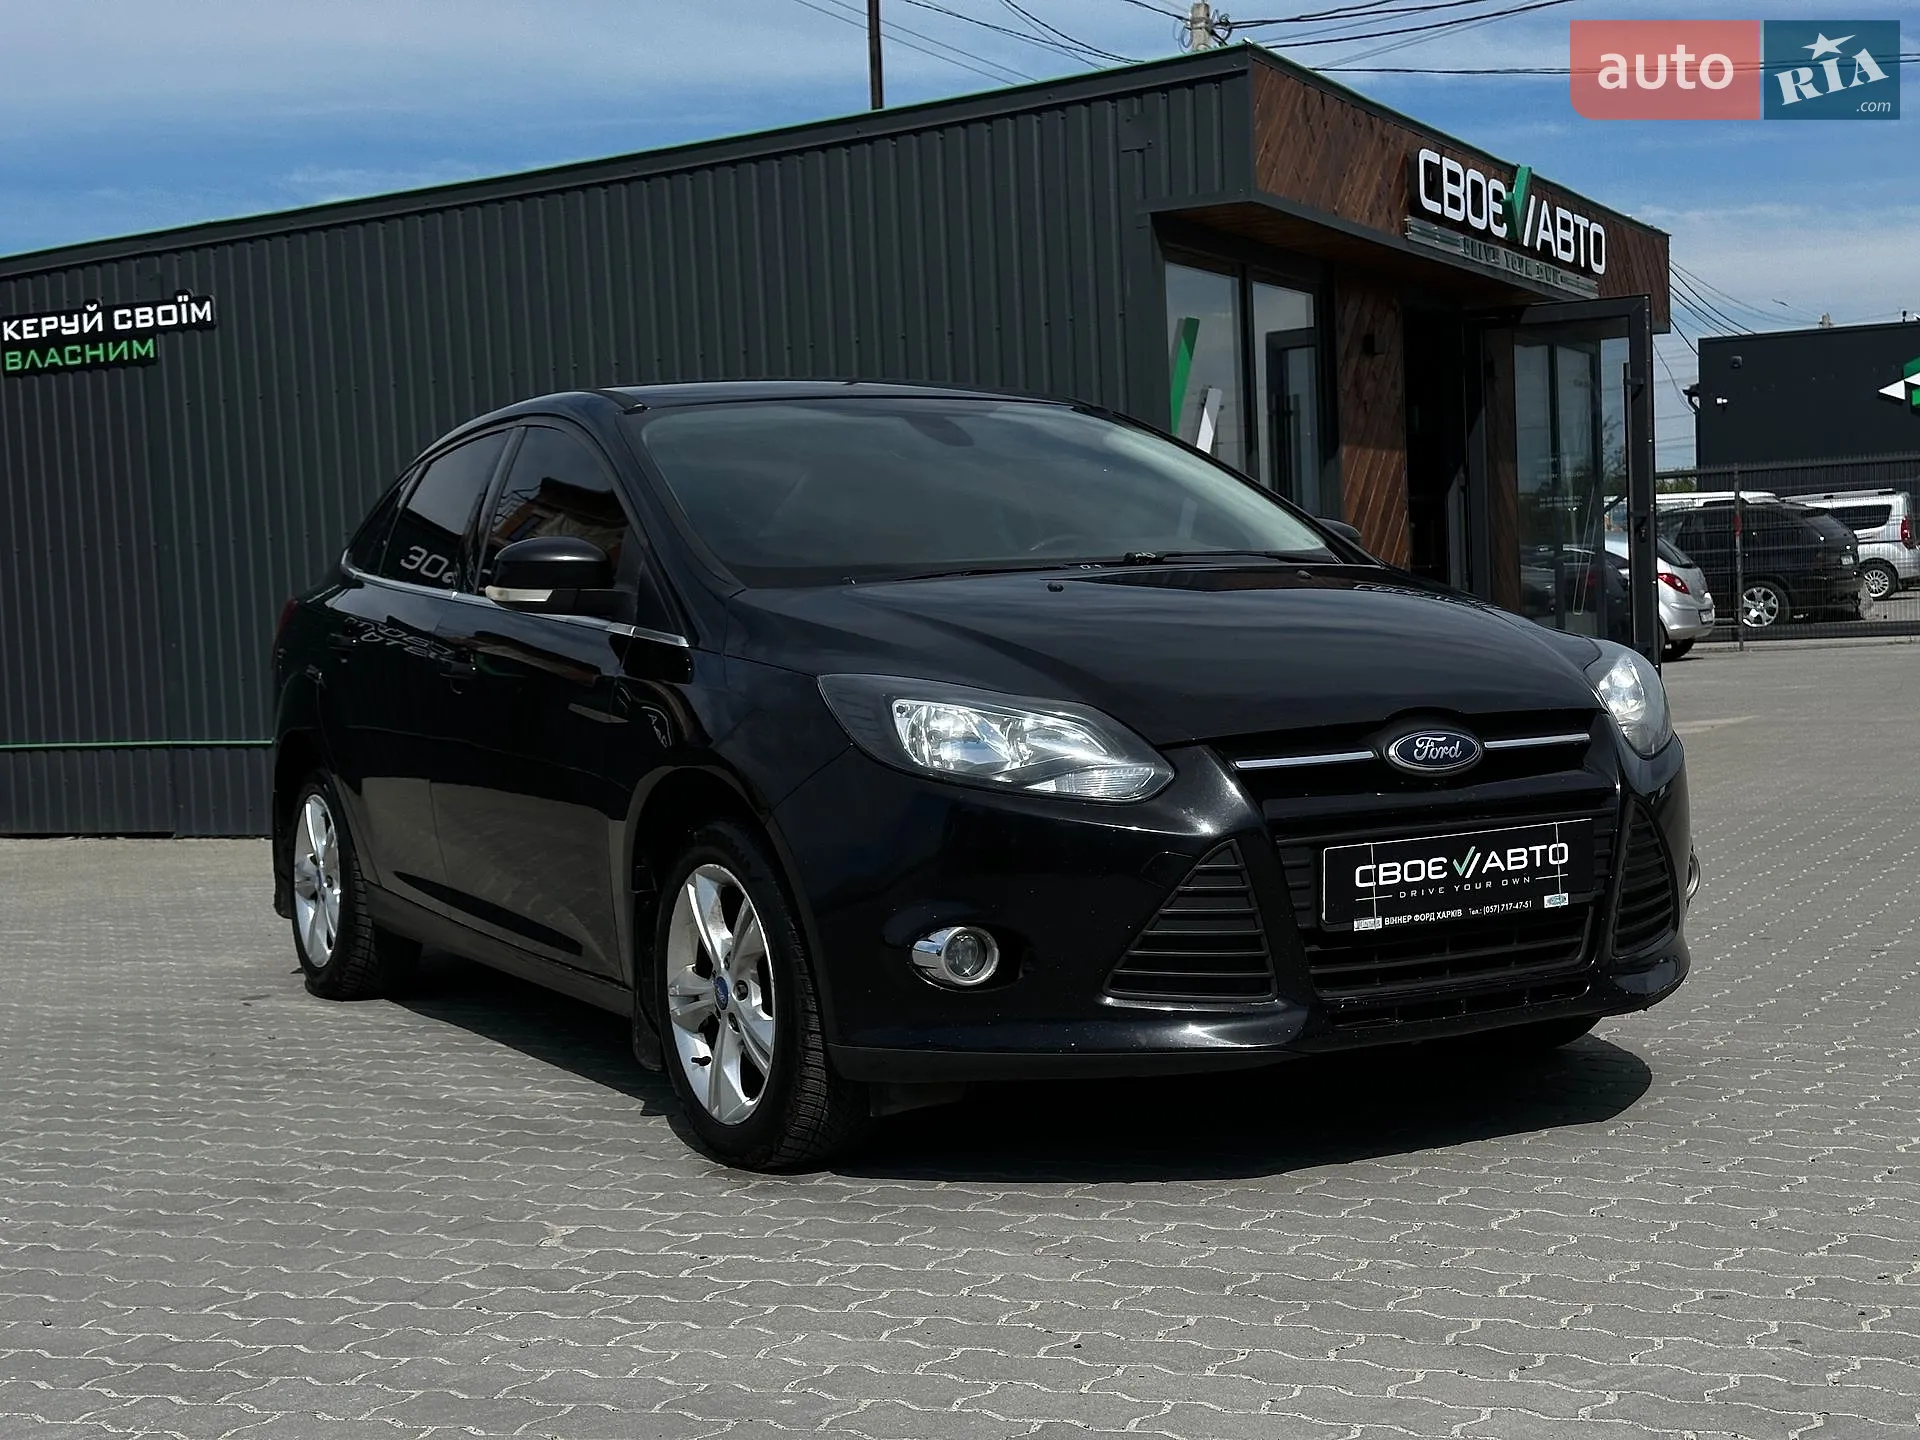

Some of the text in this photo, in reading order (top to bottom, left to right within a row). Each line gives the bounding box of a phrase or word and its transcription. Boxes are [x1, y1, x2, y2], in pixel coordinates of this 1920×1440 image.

[1418, 148, 1606, 275] СВОЄ АВТО
[2, 294, 213, 342] КЕРУЙ СВОЇМ
[4, 338, 155, 371] ВЛАСНИМ
[1413, 736, 1463, 761] Ford
[1355, 842, 1569, 888] СВОЄ АВТО
[1399, 876, 1531, 899] DRIVE YOUR OWN
[1413, 911, 1435, 922] ФОРД
[1483, 904, 1500, 915] (057)
[1500, 900, 1532, 912] 717-47-51
